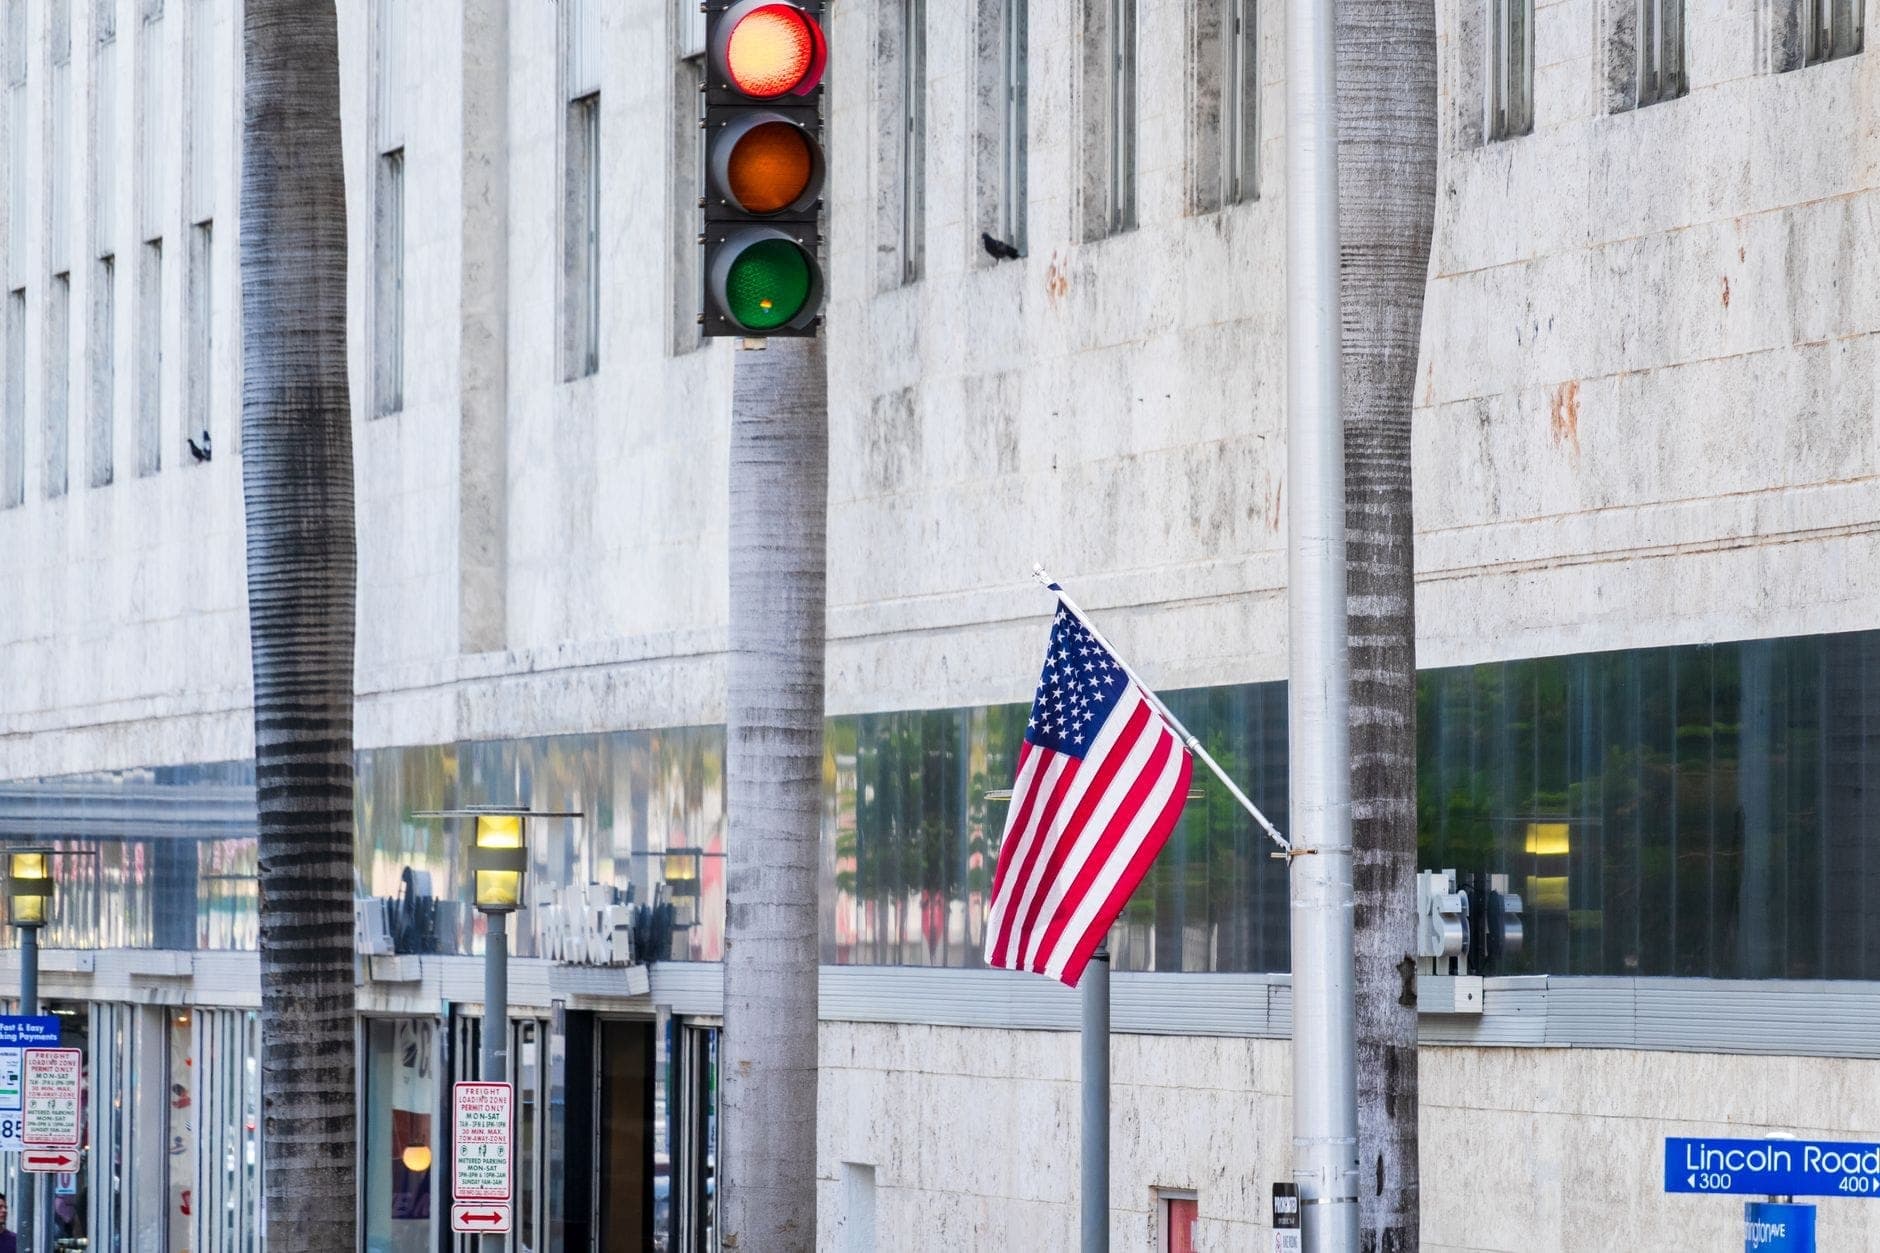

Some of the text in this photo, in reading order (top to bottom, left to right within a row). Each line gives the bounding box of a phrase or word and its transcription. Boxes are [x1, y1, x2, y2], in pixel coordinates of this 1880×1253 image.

[17, 1023, 24, 1031] &
[26, 1023, 45, 1033] Easy
[19, 1032, 58, 1042] Payments
[459, 1096, 489, 1104] LOADING
[484, 1104, 504, 1112] ONLY
[466, 1112, 500, 1120] MON-SAT
[1686, 1143, 1880, 1174] Lincoln Road
[1699, 1173, 1869, 1192] 300 400
[1771, 1223, 1786, 1237] AVE
